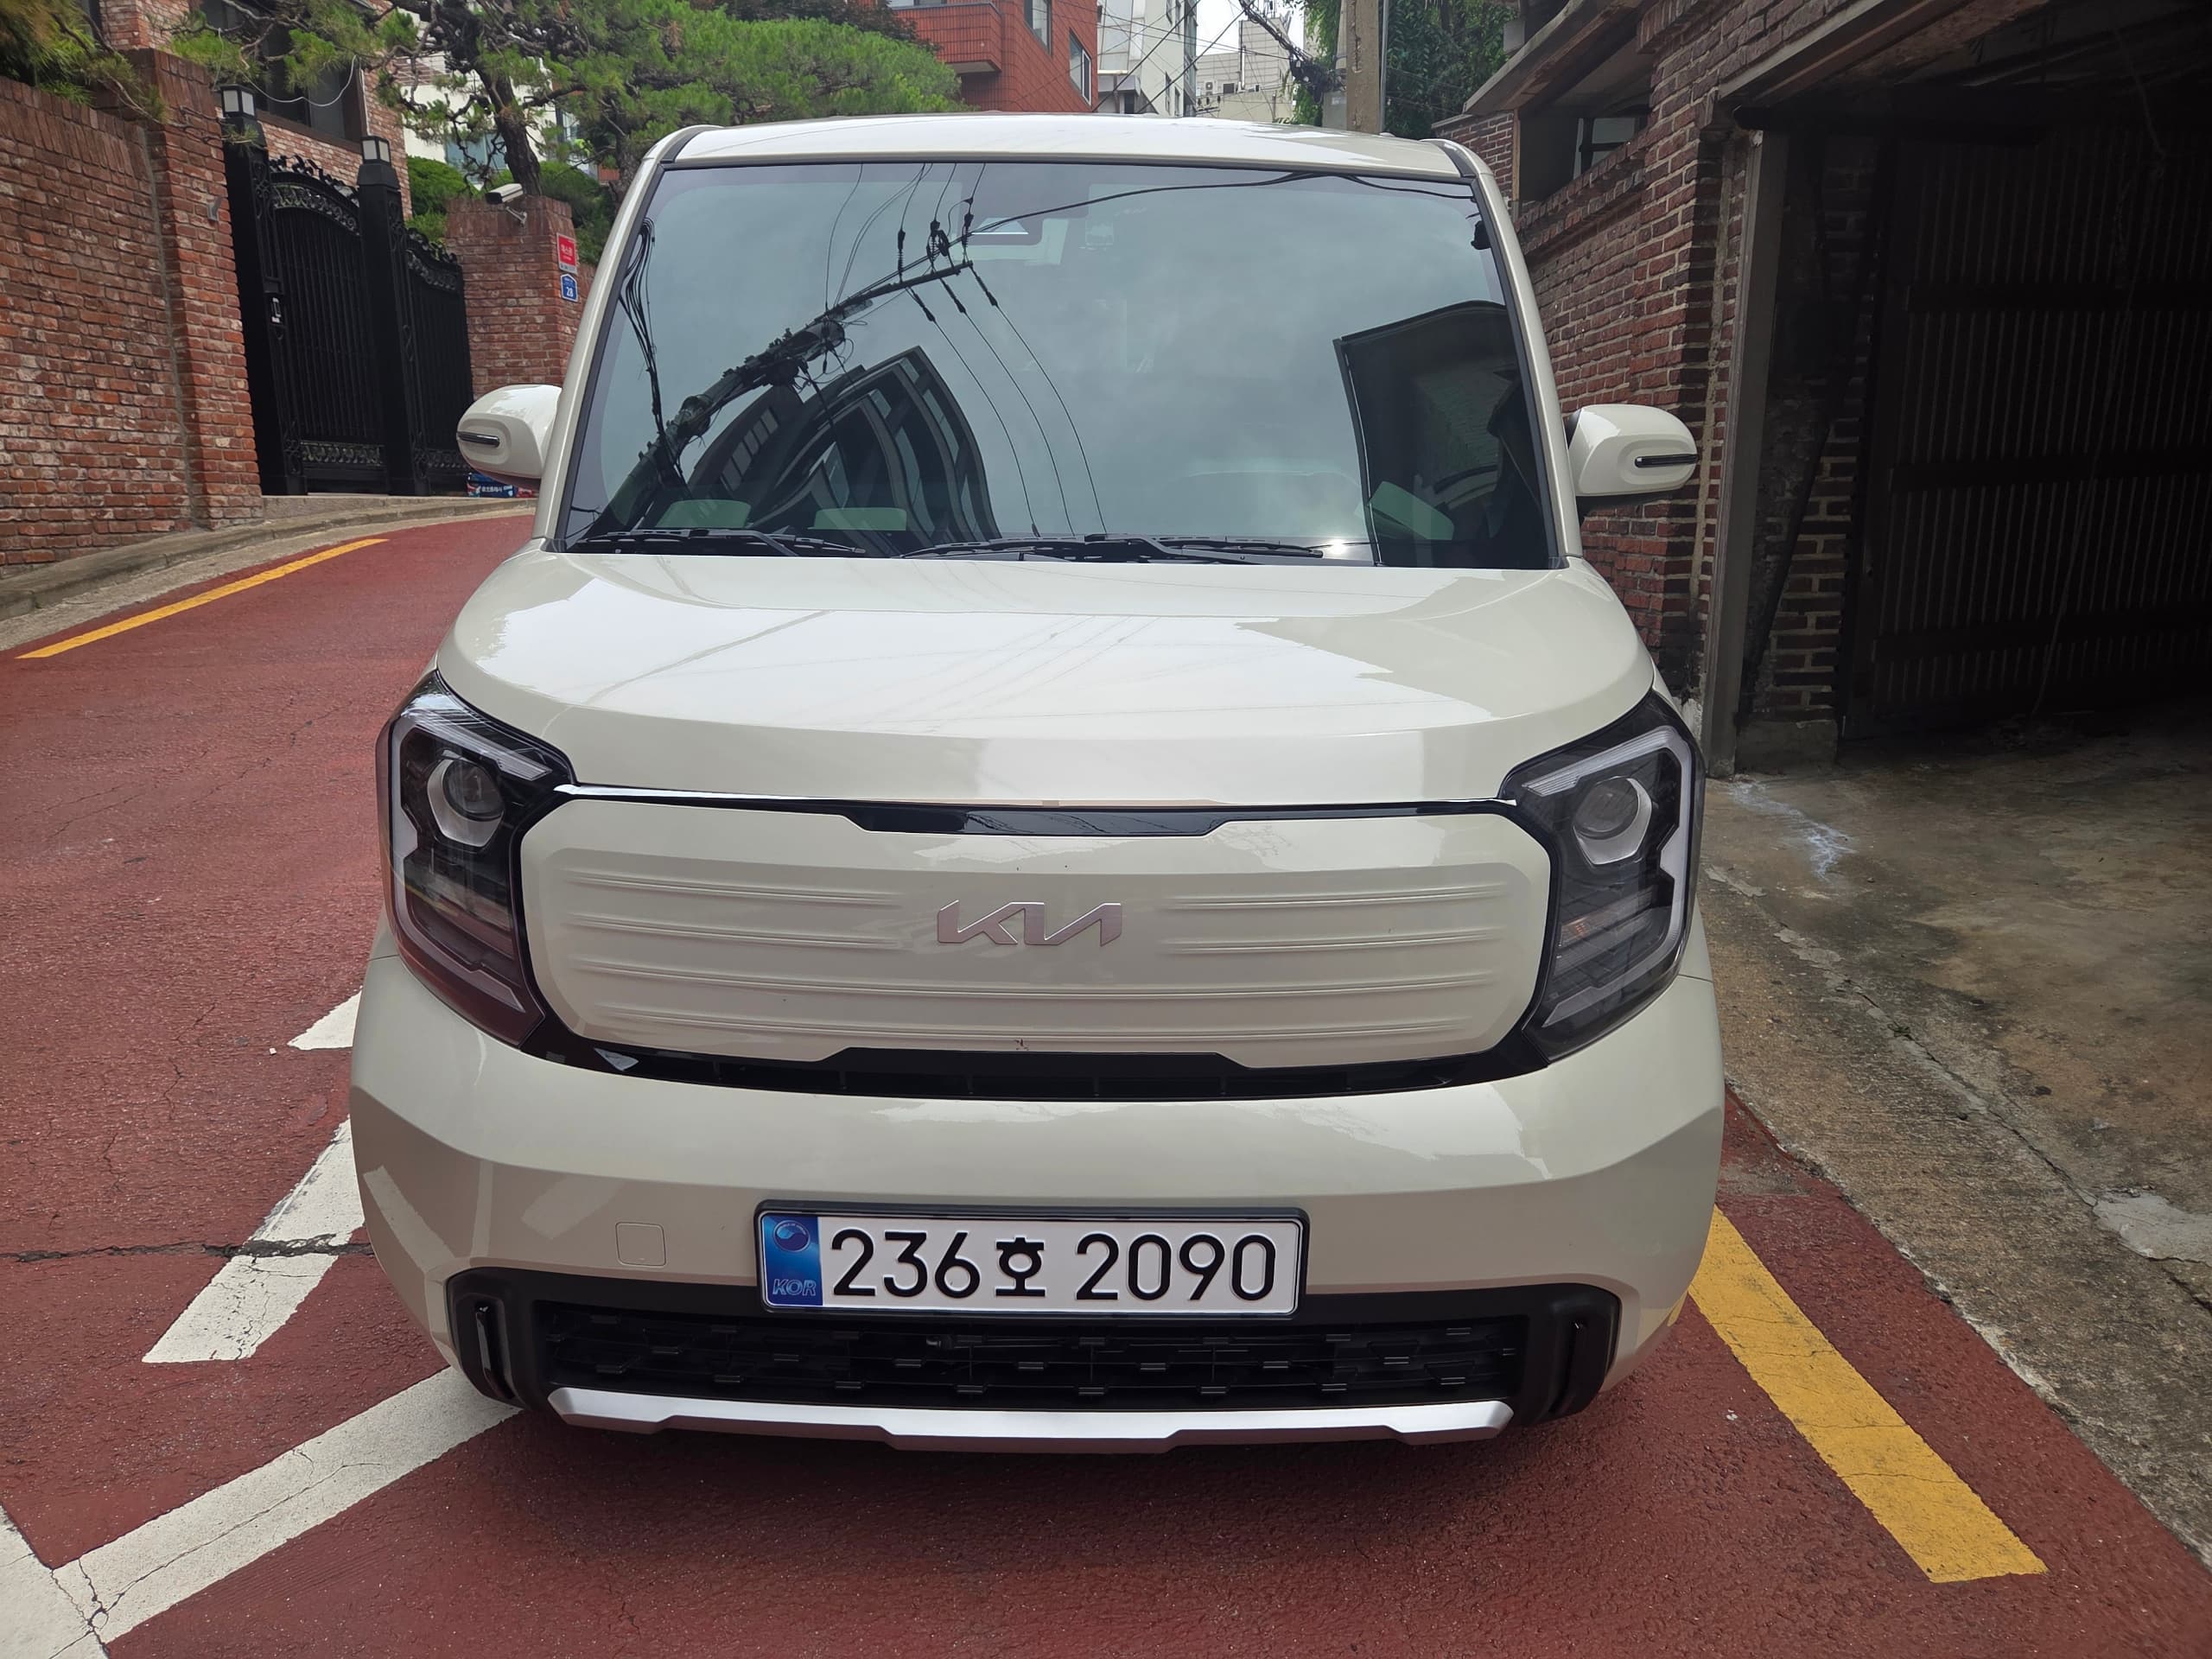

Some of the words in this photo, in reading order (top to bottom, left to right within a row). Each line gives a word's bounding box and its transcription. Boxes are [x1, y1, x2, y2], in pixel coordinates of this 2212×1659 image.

[938, 899, 1122, 947] KIA
[772, 1279, 817, 1296] KOR
[830, 1229, 1046, 1299] 236호
[1075, 1233, 1277, 1301] 2090
